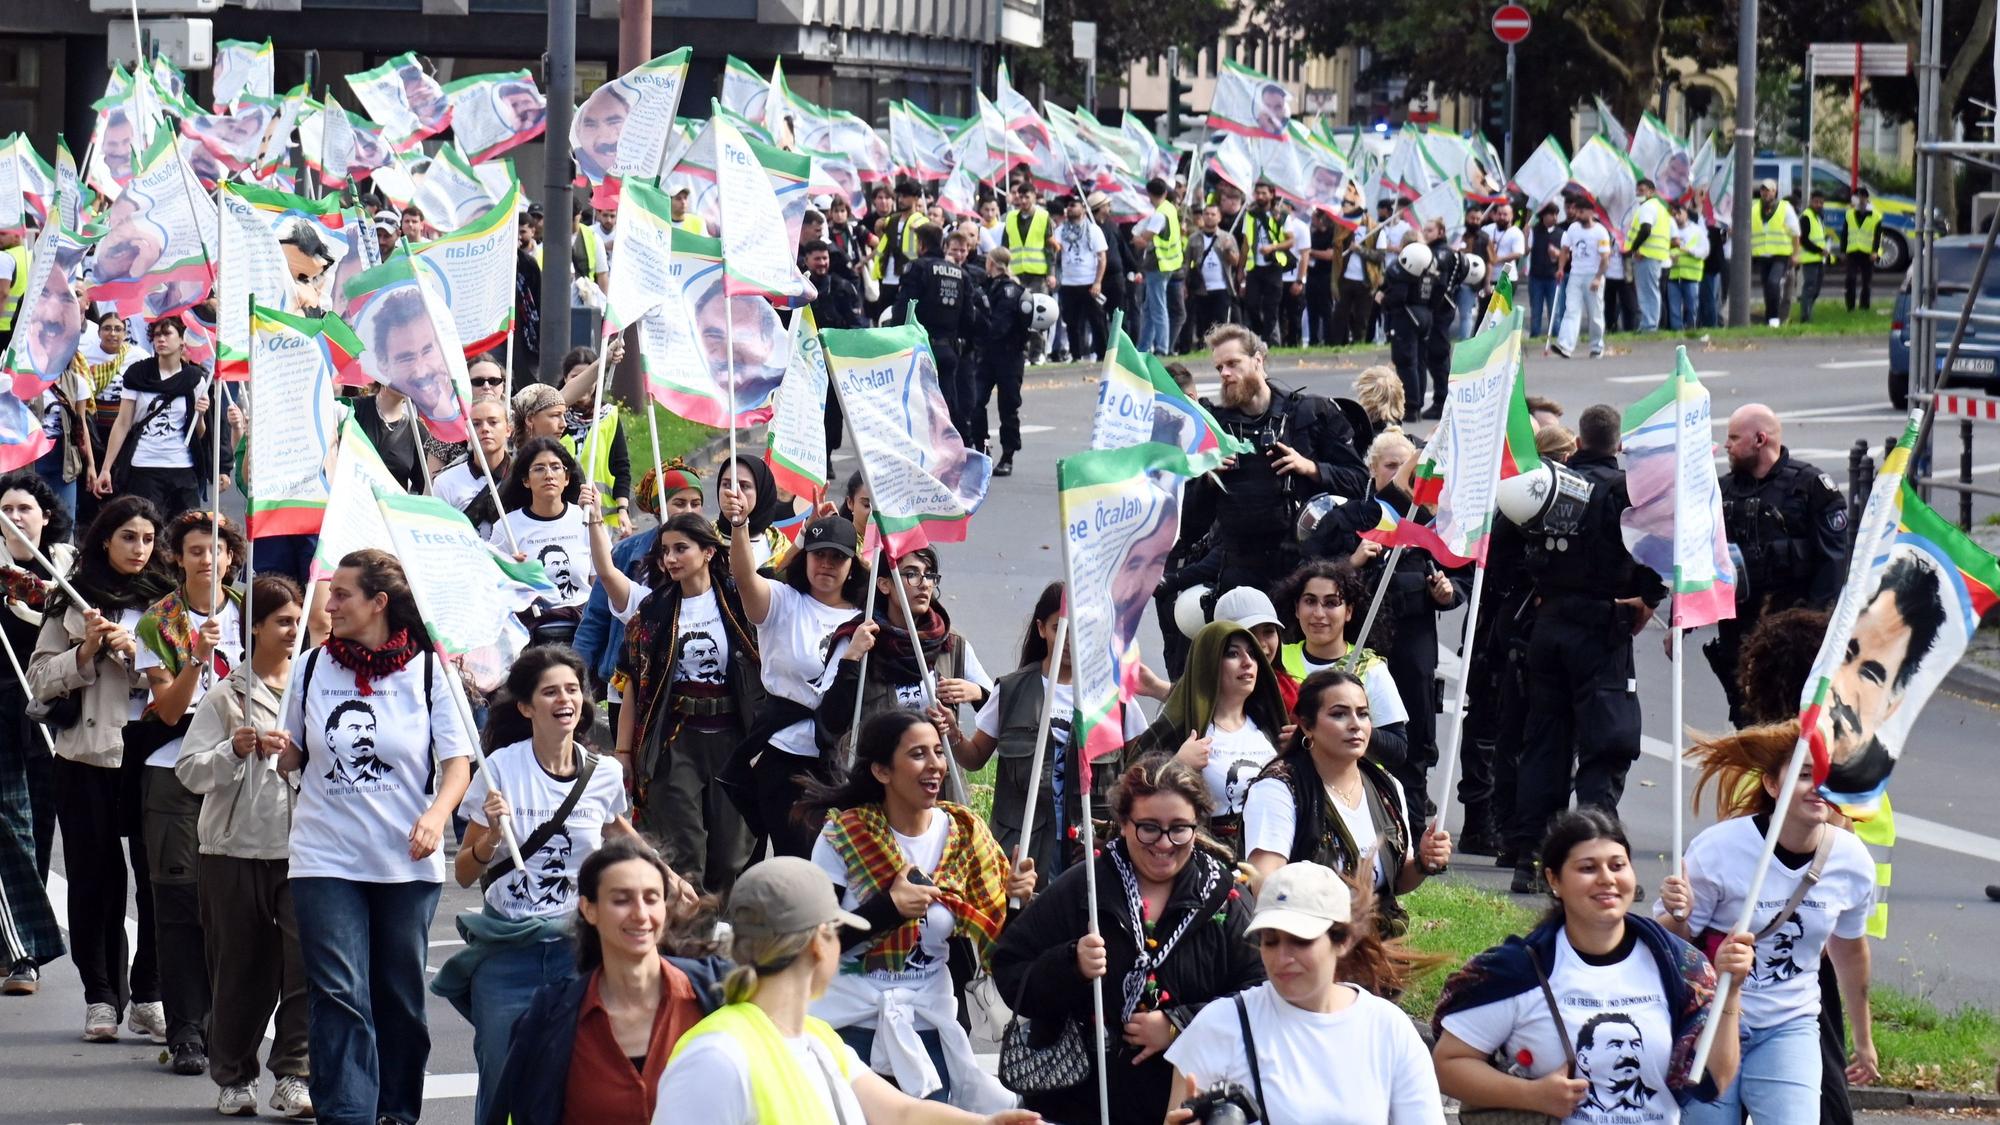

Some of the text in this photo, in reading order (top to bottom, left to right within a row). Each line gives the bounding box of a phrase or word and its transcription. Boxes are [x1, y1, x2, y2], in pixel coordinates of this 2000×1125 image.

[46, 234, 59, 248] ree
[932, 264, 962, 279] POLIZEI
[1096, 496, 1141, 532] Öcalan
[1563, 997, 1577, 1006] FÜR
[1577, 998, 1604, 1007] FREIHEIT
[1621, 994, 1661, 1006] DEMOKRATIE
